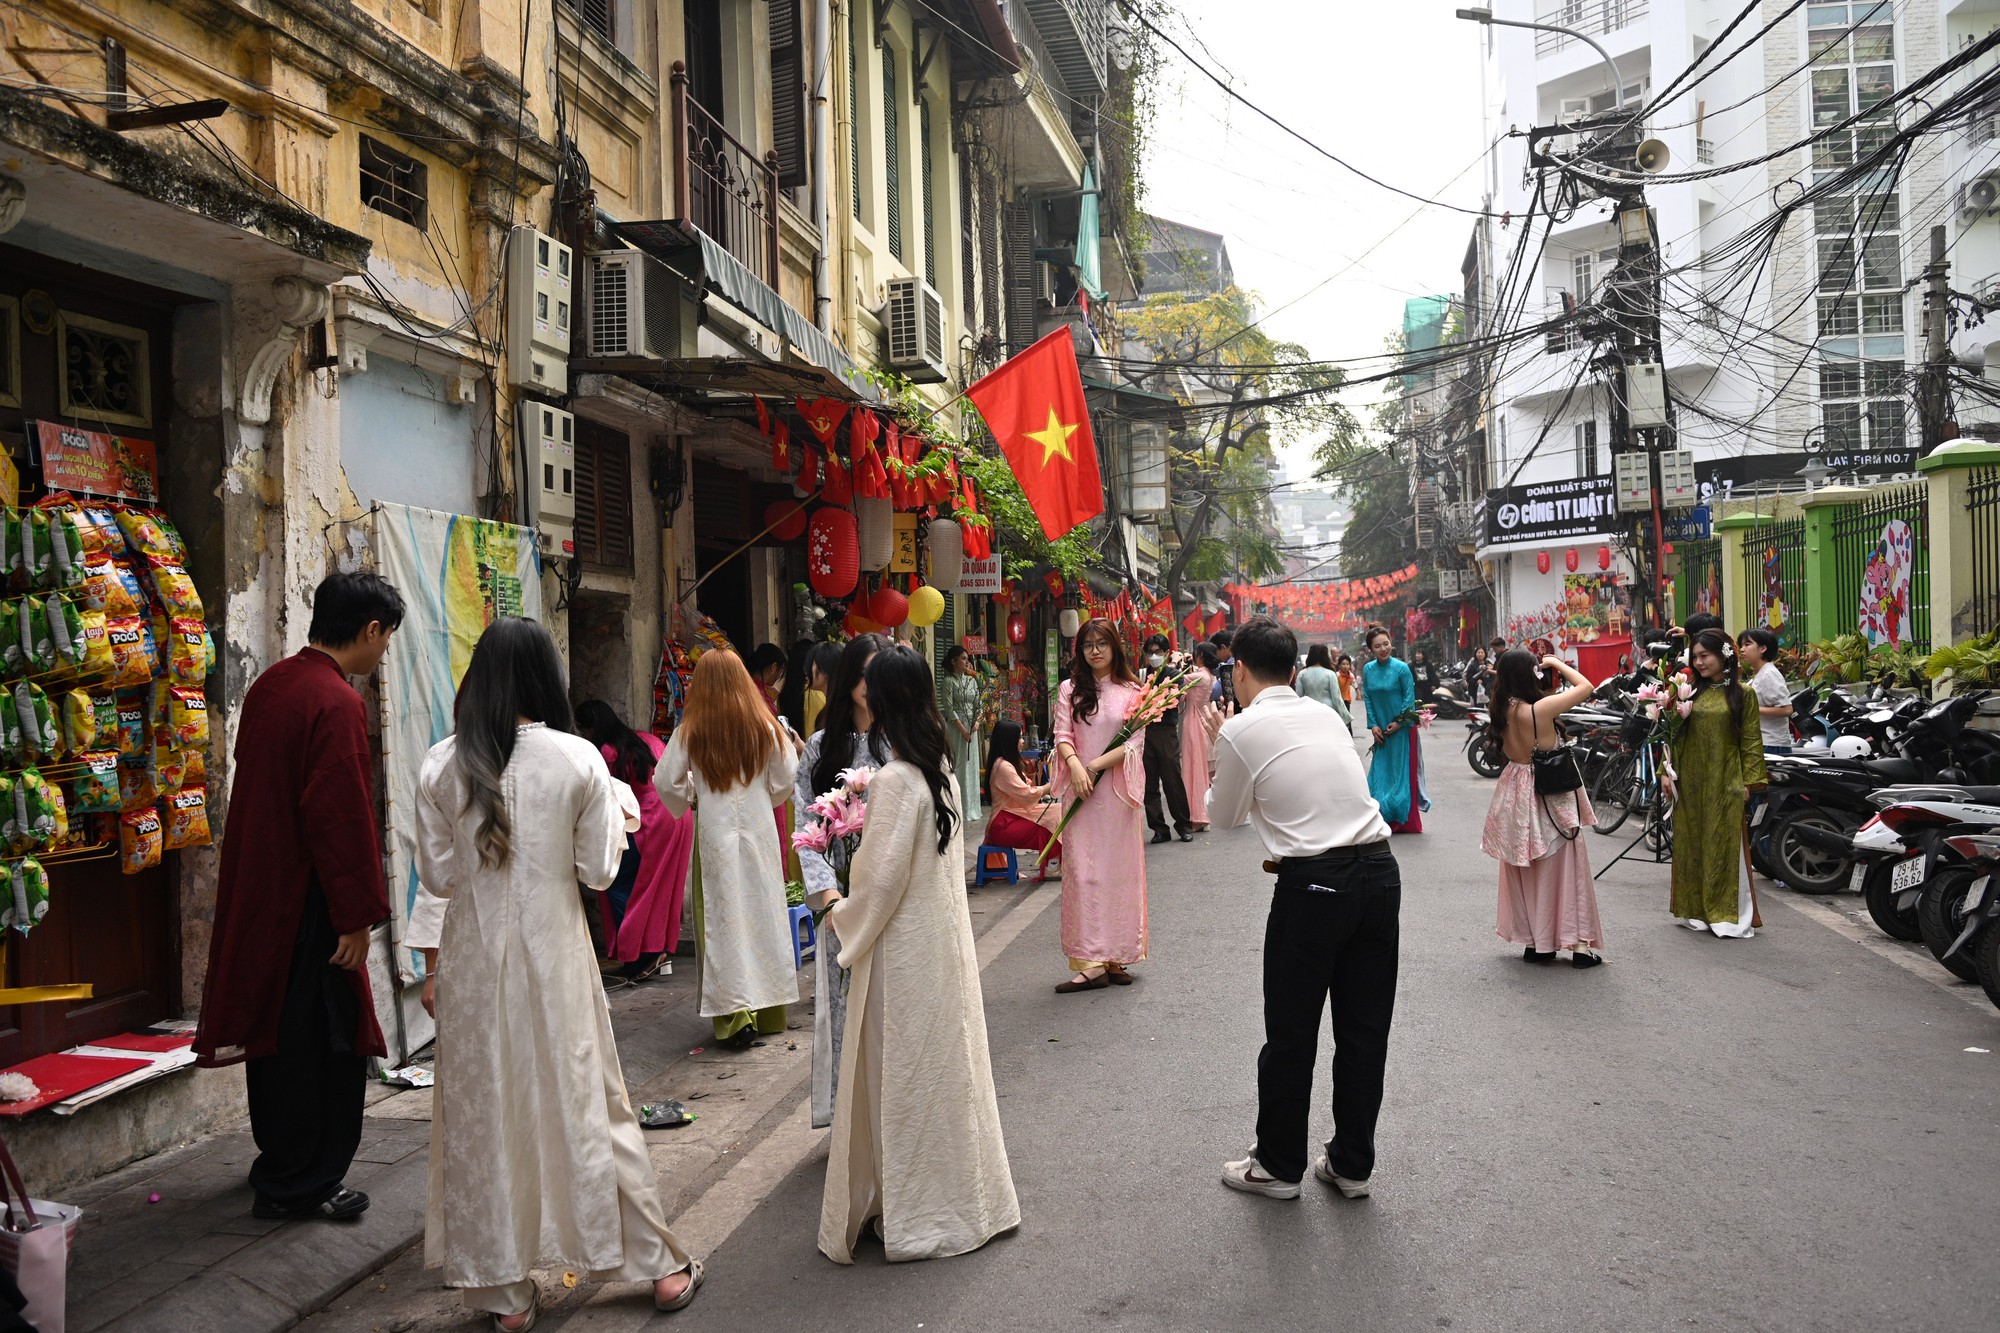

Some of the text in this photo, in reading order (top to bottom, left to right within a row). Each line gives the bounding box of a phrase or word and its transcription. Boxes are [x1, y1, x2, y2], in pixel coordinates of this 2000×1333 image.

[61, 432, 88, 449] POCA
[82, 454, 93, 466] 10
[1884, 453, 1910, 464] NO.7
[76, 465, 88, 478] 10
[1526, 477, 1613, 497] ĐOÀN LUẬT SƯ TH
[1520, 499, 1555, 525] CÔNG
[1555, 499, 1572, 521] TY
[1572, 492, 1605, 522] LUẬT
[974, 578, 986, 588] 533
[111, 631, 140, 645] POCA
[186, 699, 206, 709] POCA
[120, 710, 142, 722] POCA
[175, 797, 203, 809] POCA
[138, 820, 159, 834] POCA
[1897, 858, 1921, 877] 29-AE
[1893, 870, 1922, 890] 536.62
